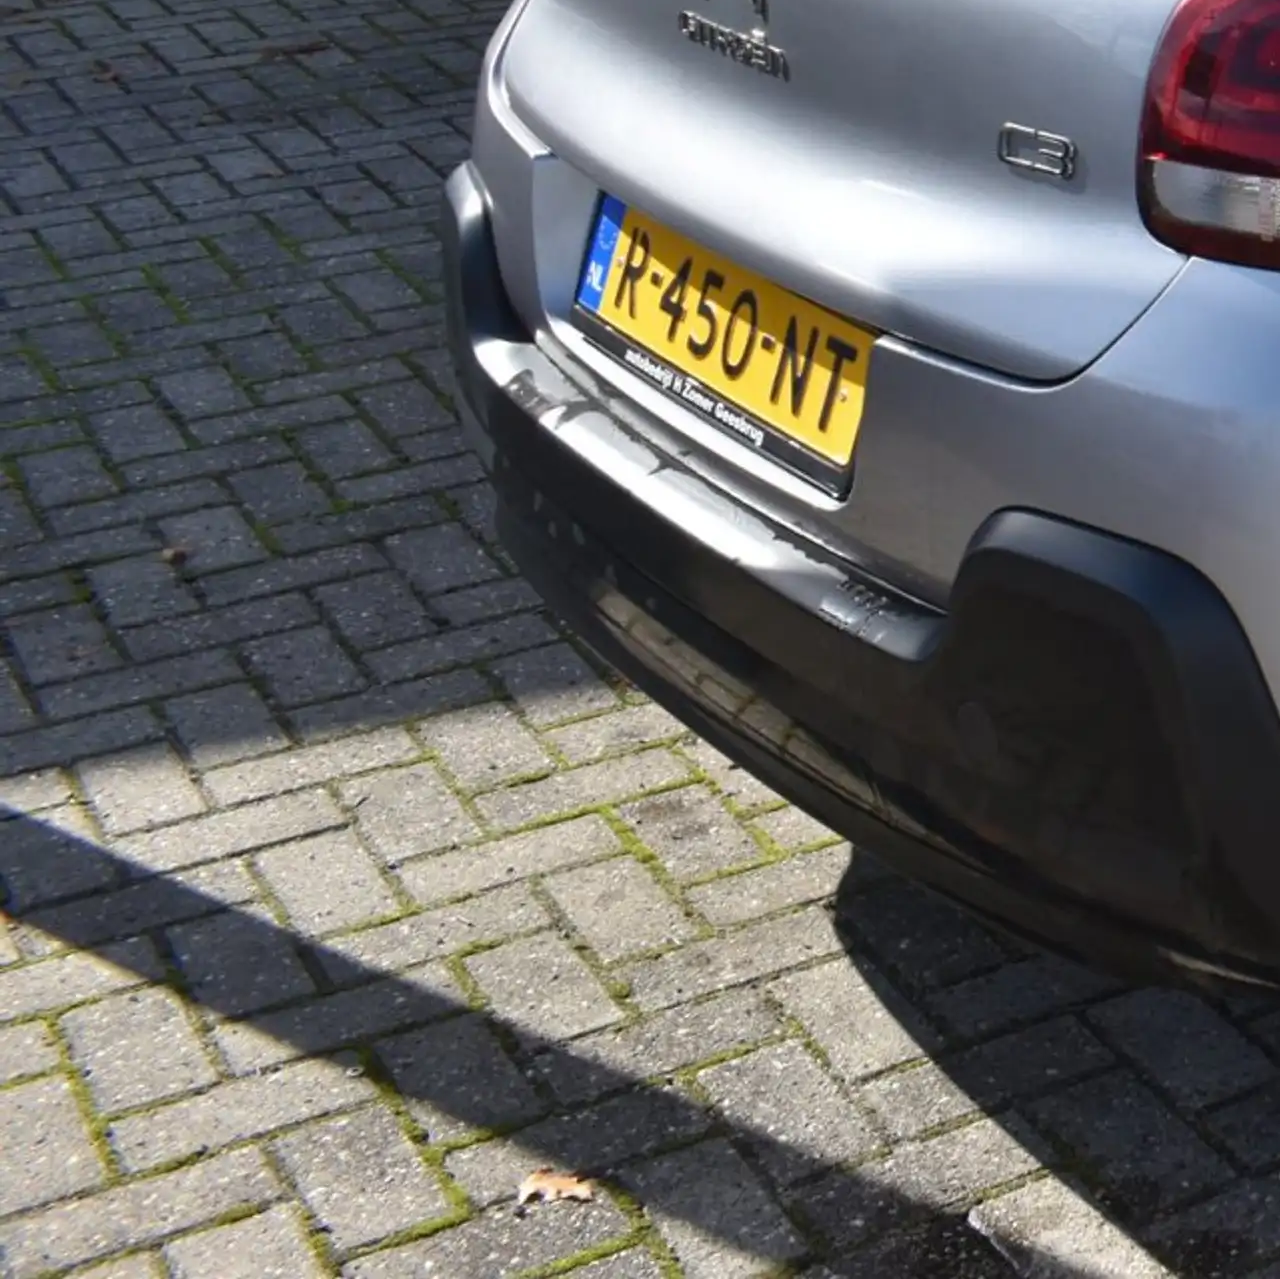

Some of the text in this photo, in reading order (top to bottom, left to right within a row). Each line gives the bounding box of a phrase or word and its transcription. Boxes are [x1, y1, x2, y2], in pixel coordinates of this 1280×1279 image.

[997, 122, 1078, 181] C3
[587, 260, 602, 291] NL
[614, 226, 857, 433] R-450-NT
[682, 381, 714, 413] Zomer
[714, 402, 764, 447] Geesbrug
